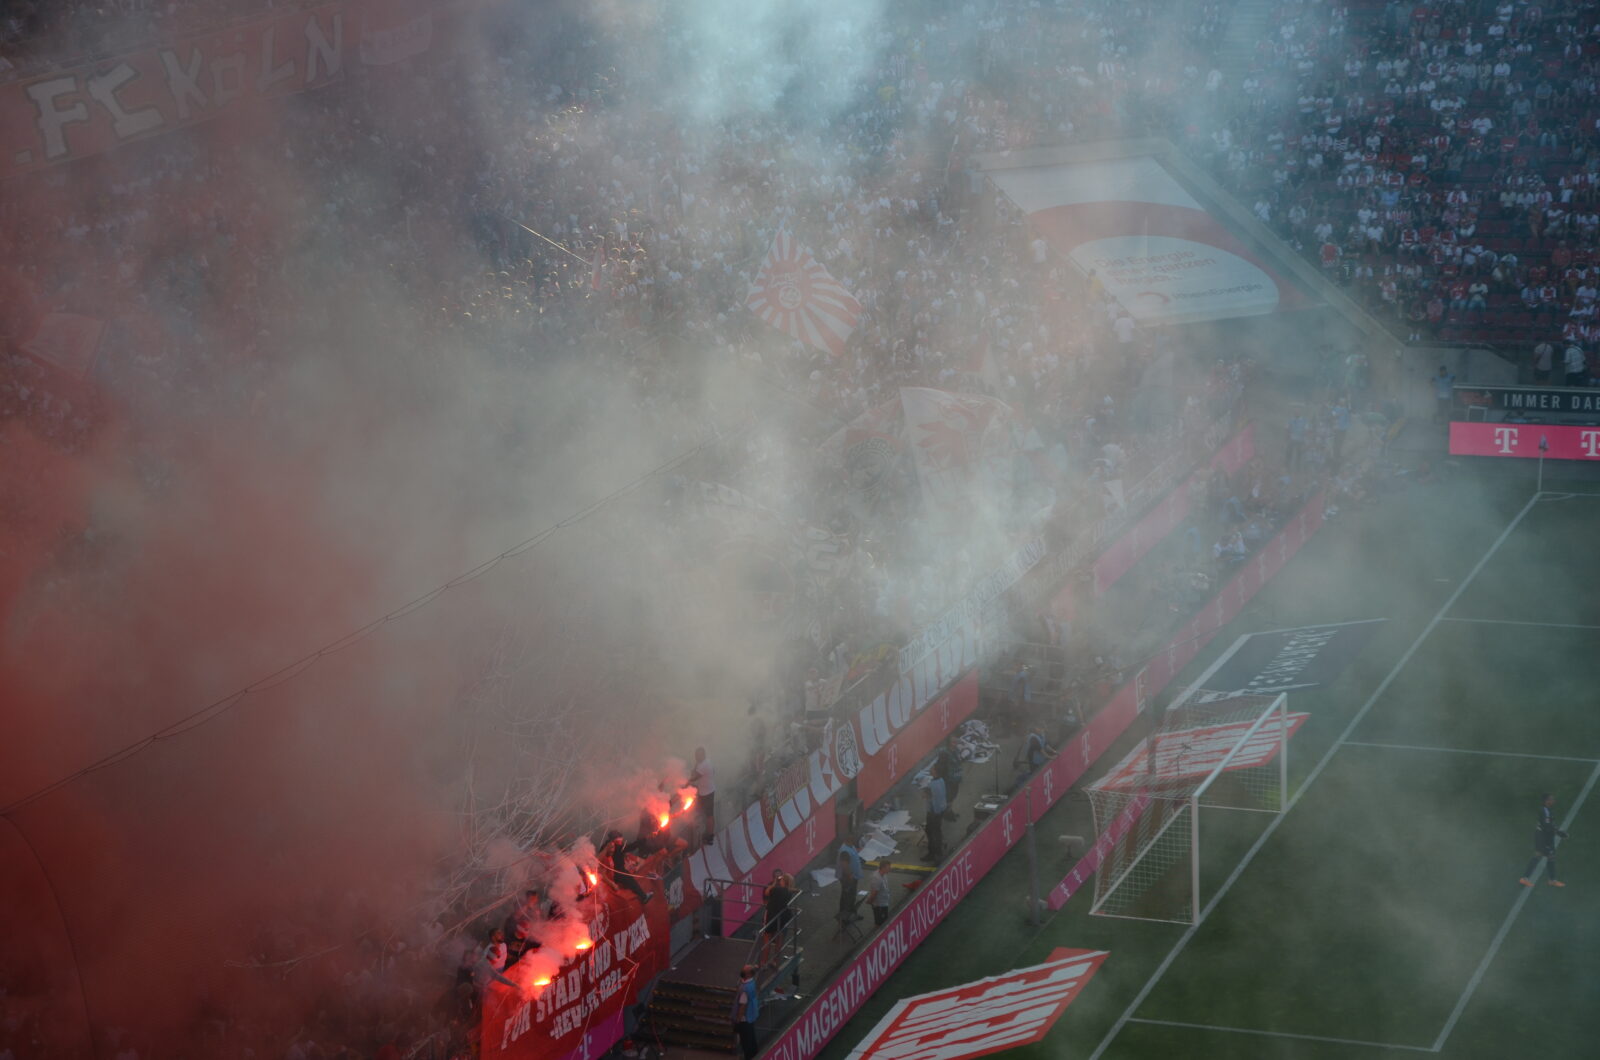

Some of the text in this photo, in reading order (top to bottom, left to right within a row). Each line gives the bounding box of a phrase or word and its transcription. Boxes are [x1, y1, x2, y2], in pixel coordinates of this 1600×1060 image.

[1504, 393, 1560, 409] IMMER
[796, 970, 866, 1060] MAGENTA
[866, 921, 908, 989] MOBIL
[909, 850, 973, 940] ANGEBOTE
